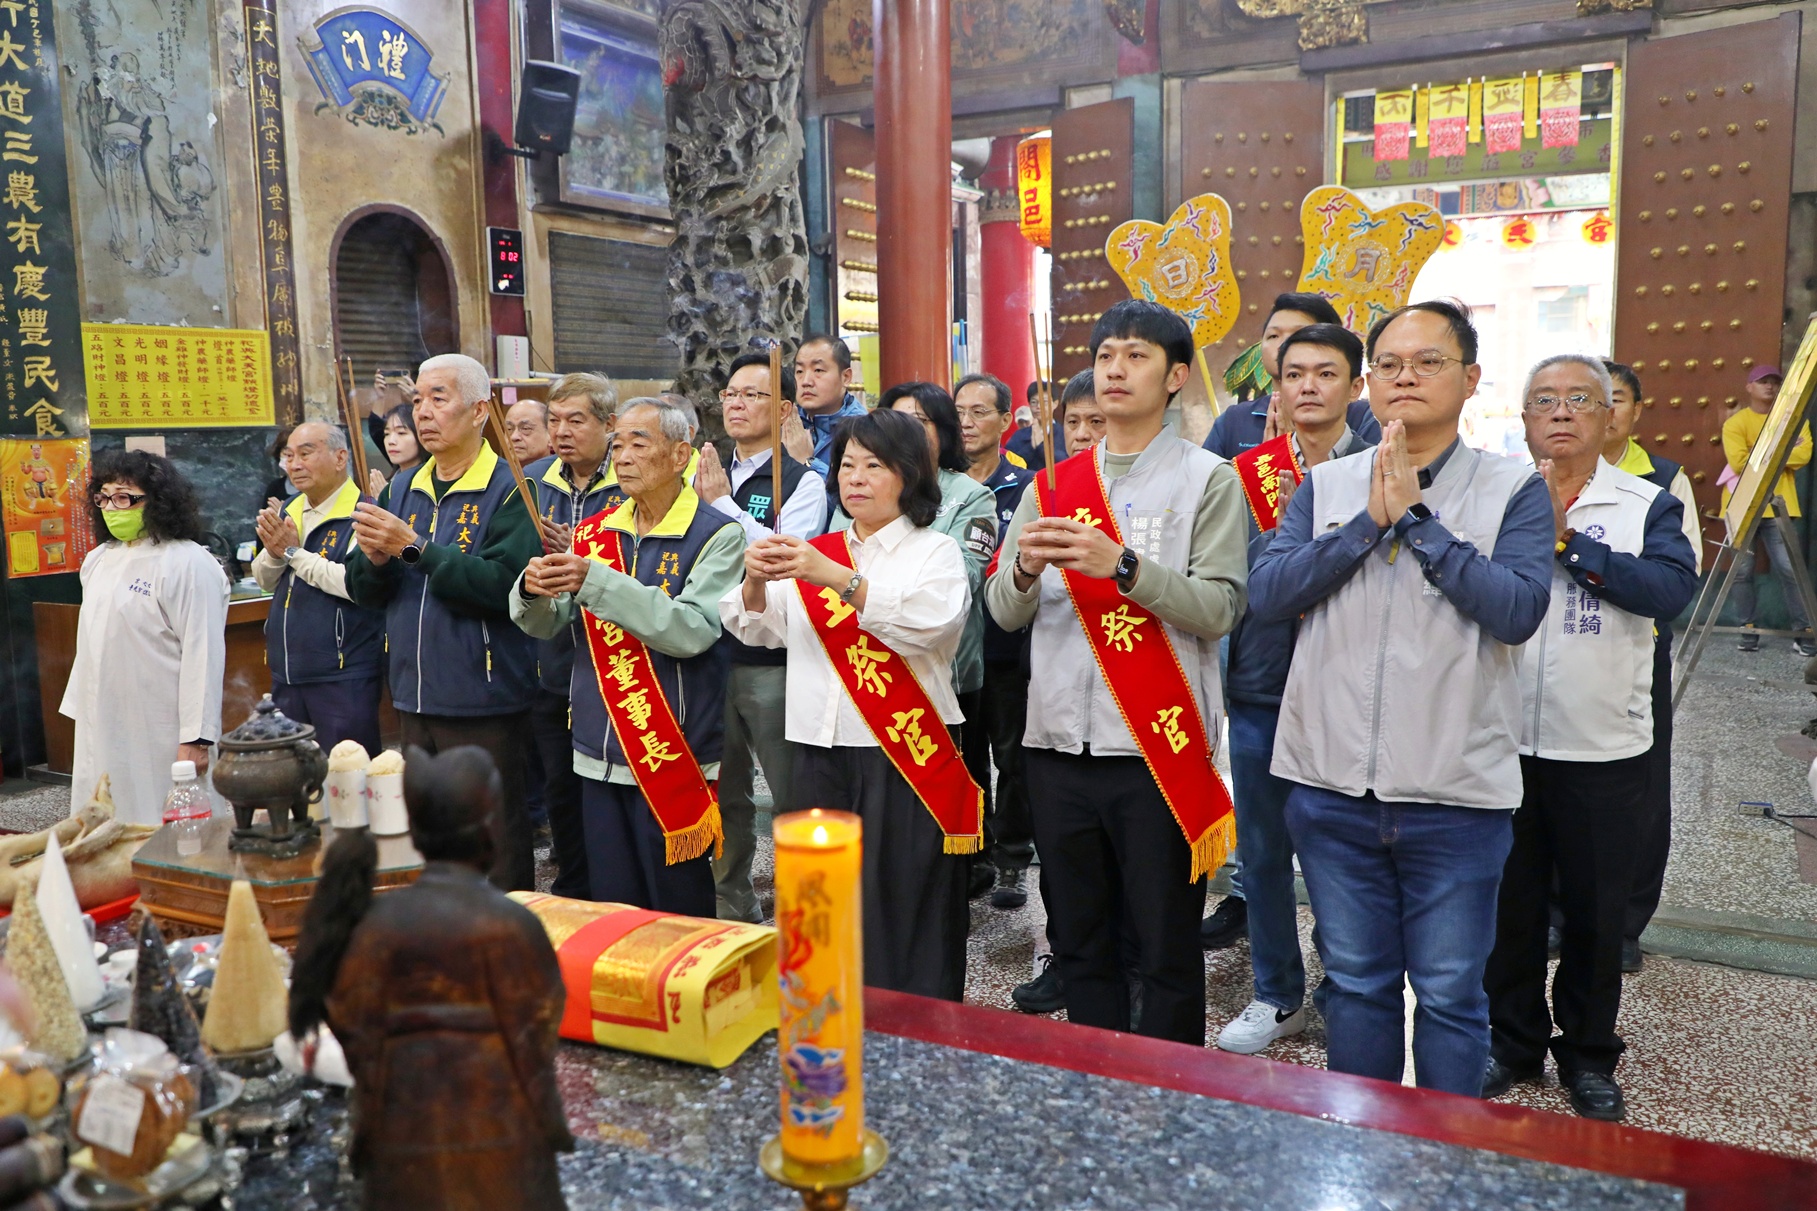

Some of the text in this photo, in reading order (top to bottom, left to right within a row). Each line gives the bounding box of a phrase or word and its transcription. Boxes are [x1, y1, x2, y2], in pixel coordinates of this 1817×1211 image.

[1161, 257, 1189, 289] 日
[1344, 248, 1381, 282] 月
[1252, 453, 1280, 518] 嘉邑南門
[747, 494, 771, 519] 眾
[656, 562, 680, 577] 嘉義
[662, 552, 679, 563] 祀典
[1563, 582, 1577, 635] 服務團隊
[1579, 590, 1602, 635] 倩綺
[818, 586, 939, 767] 主祭官
